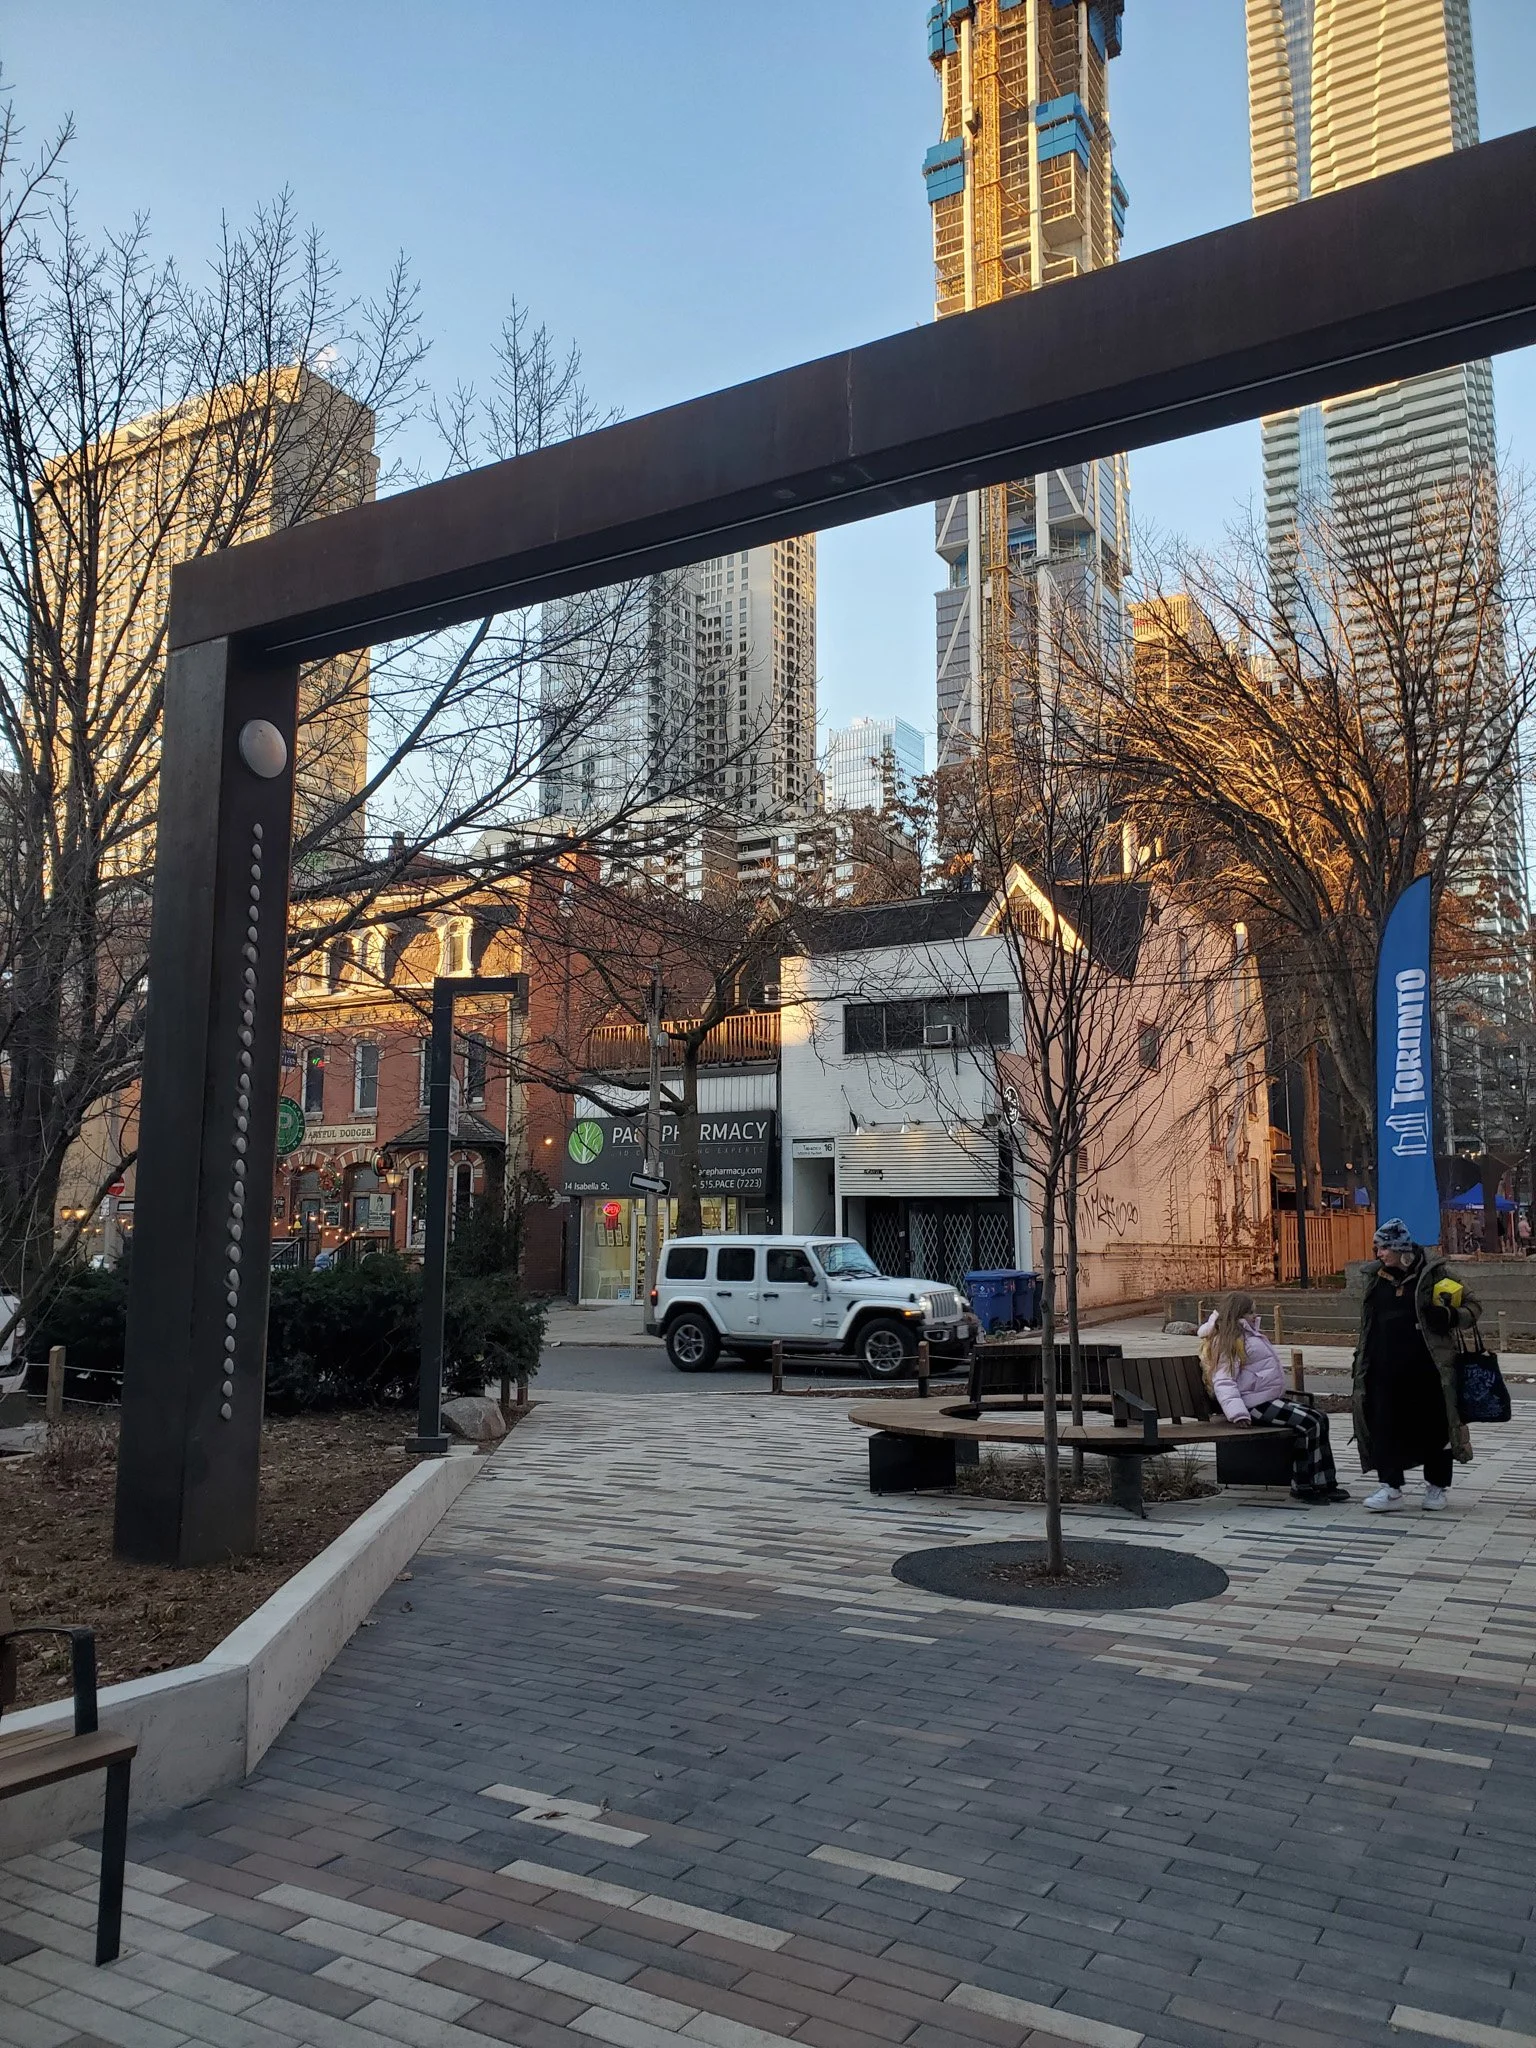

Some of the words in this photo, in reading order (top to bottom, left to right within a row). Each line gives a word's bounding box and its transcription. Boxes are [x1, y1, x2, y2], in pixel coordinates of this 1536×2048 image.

[1390, 968, 1426, 1109] TORONTO
[824, 1143, 833, 1152] 16
[564, 1182, 573, 1190] 14
[574, 1182, 599, 1191] Isabella
[600, 1181, 610, 1191] St.
[736, 1178, 762, 1189] (7223)
